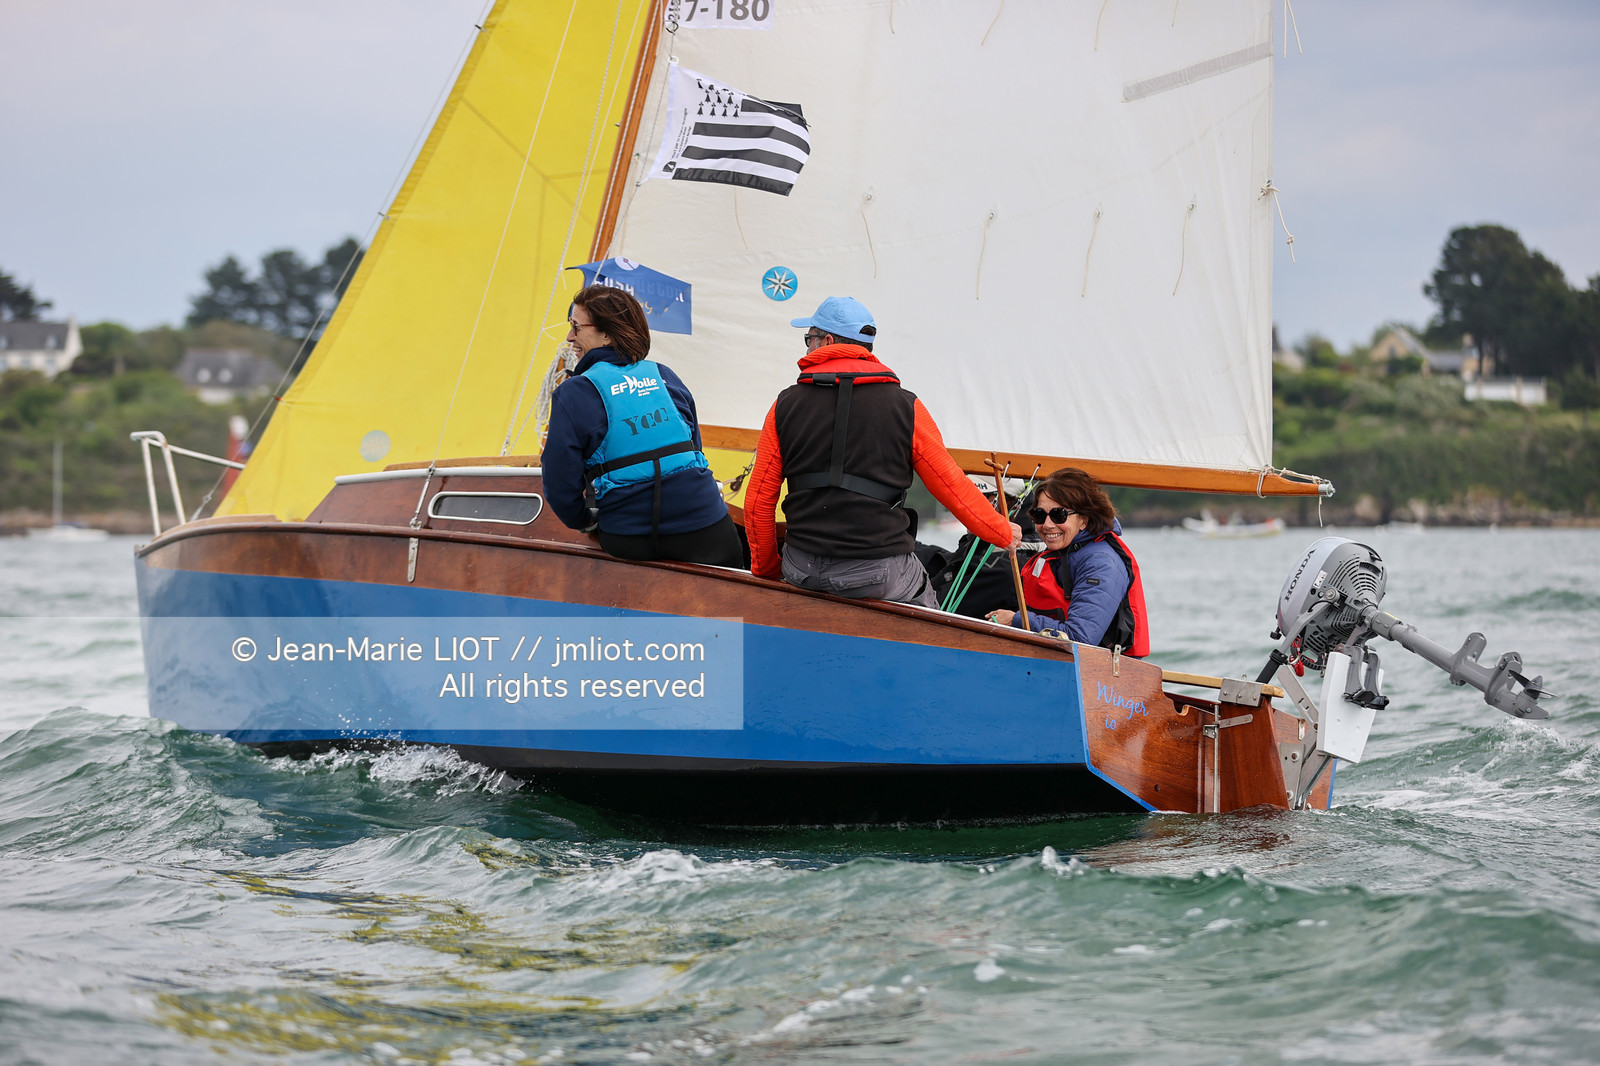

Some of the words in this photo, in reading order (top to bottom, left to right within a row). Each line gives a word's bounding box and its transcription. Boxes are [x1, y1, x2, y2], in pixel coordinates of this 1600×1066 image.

[621, 407, 669, 436] YCC
[1284, 548, 1316, 602] HONDA
[1097, 680, 1150, 720] Winger
